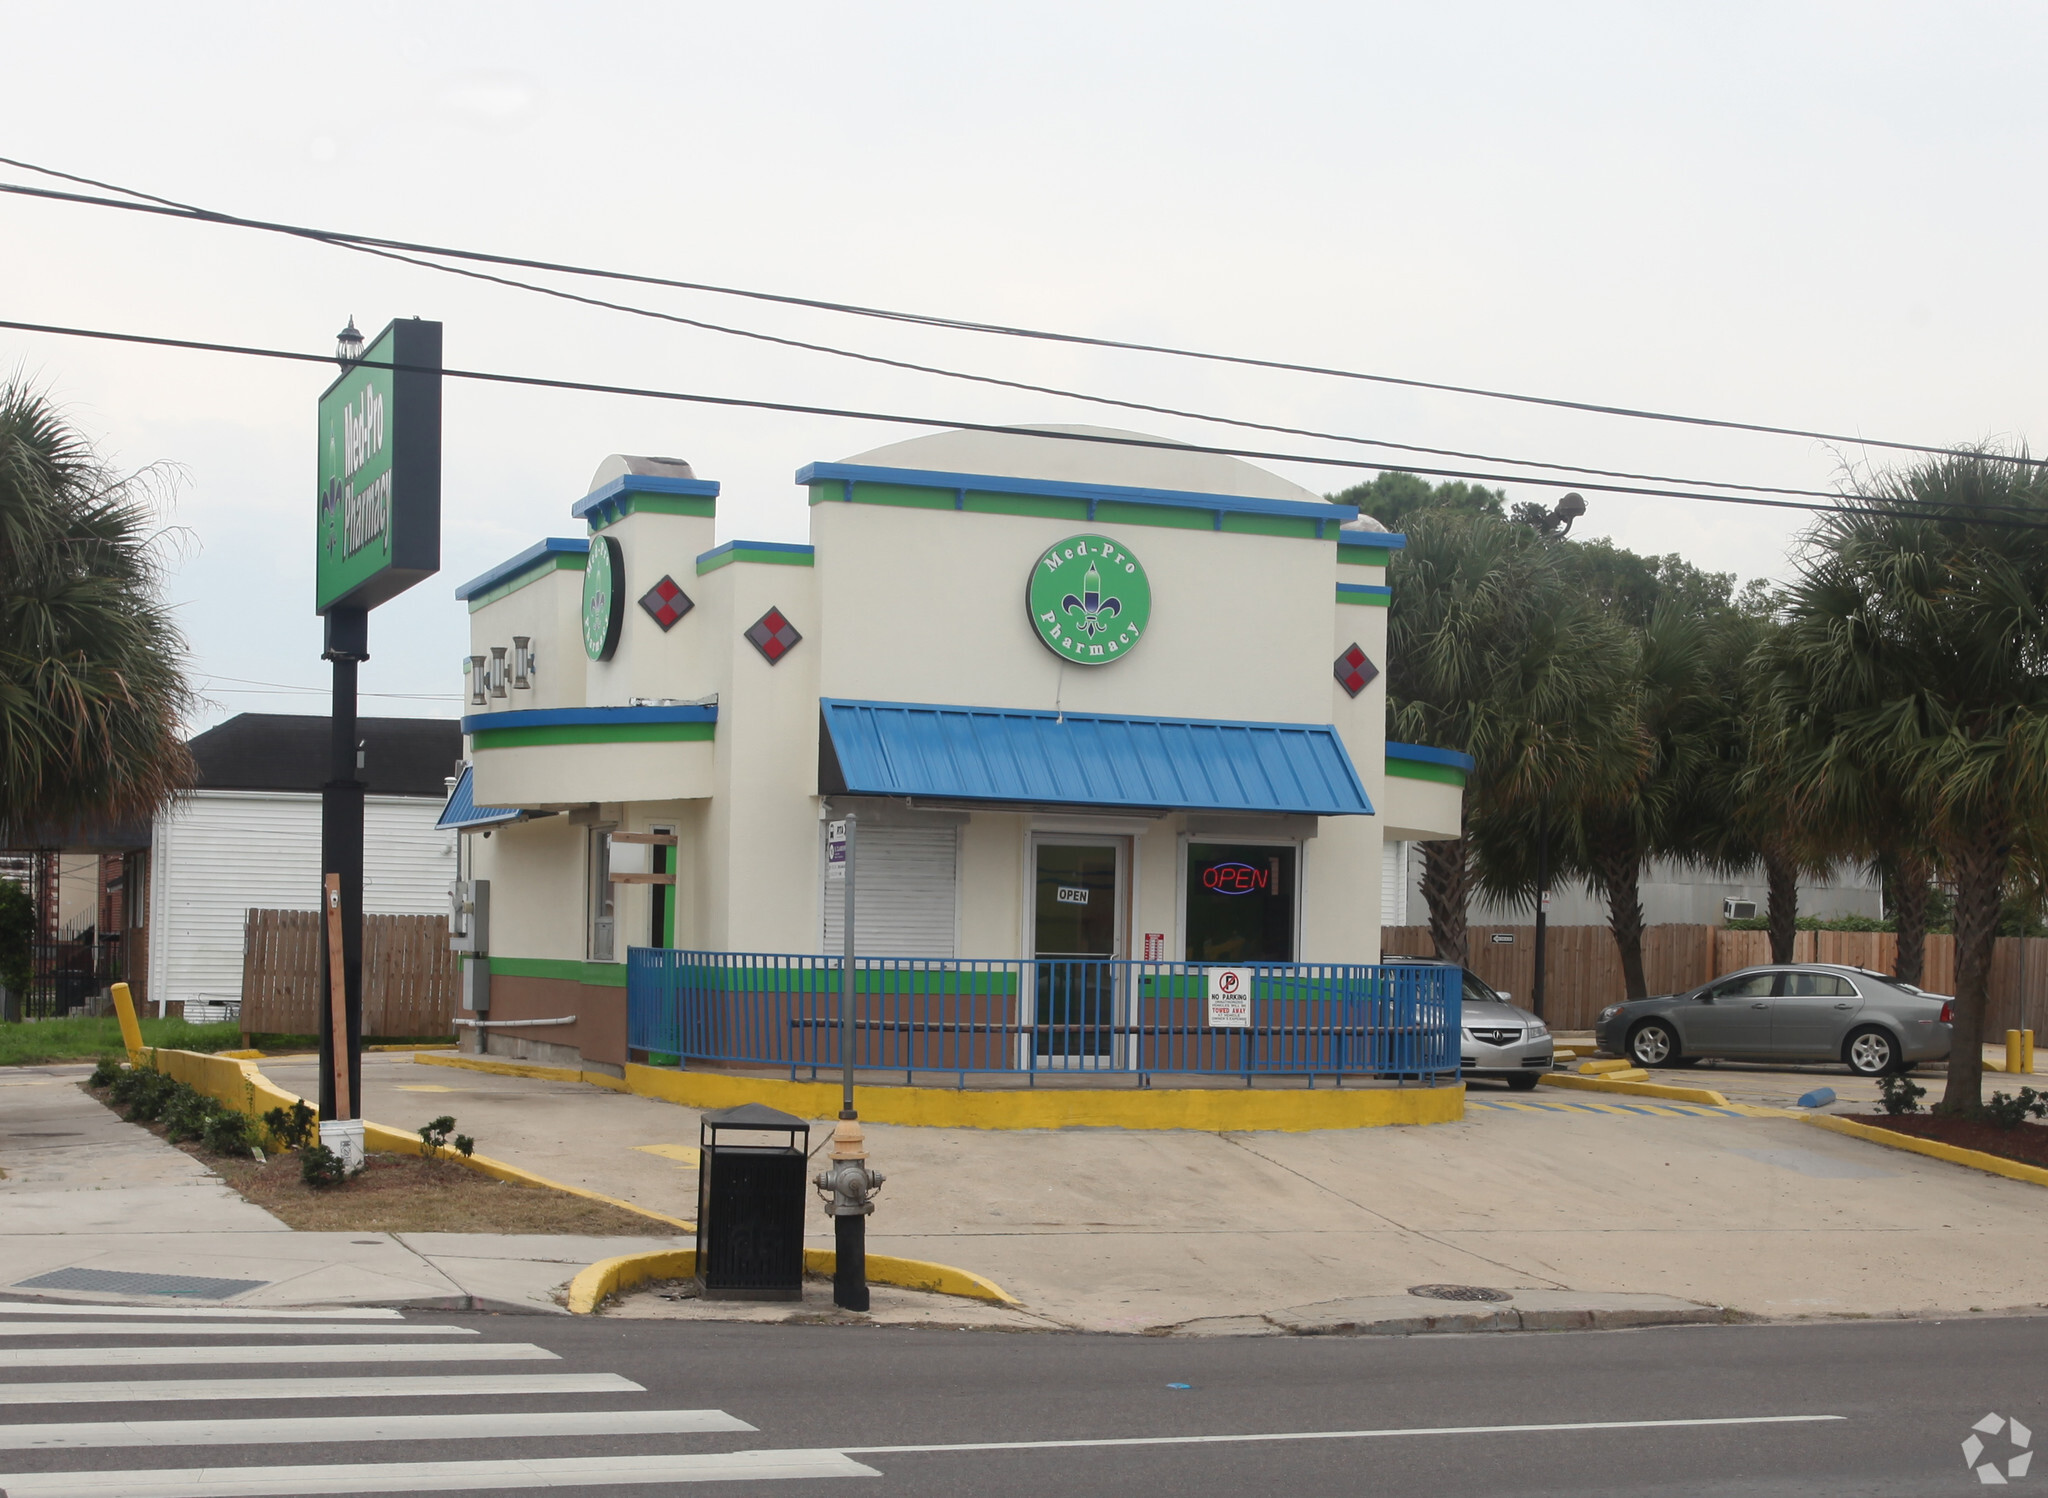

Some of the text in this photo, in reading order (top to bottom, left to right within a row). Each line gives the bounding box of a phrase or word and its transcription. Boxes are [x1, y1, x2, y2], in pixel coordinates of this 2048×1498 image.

[344, 383, 384, 478] Med-Pro
[343, 468, 392, 557] Pharmacy
[1043, 541, 1136, 573] Med-Pro
[1041, 610, 1140, 656] Pharmacy
[1059, 889, 1087, 902] OPEN
[1203, 868, 1268, 888] OPEN
